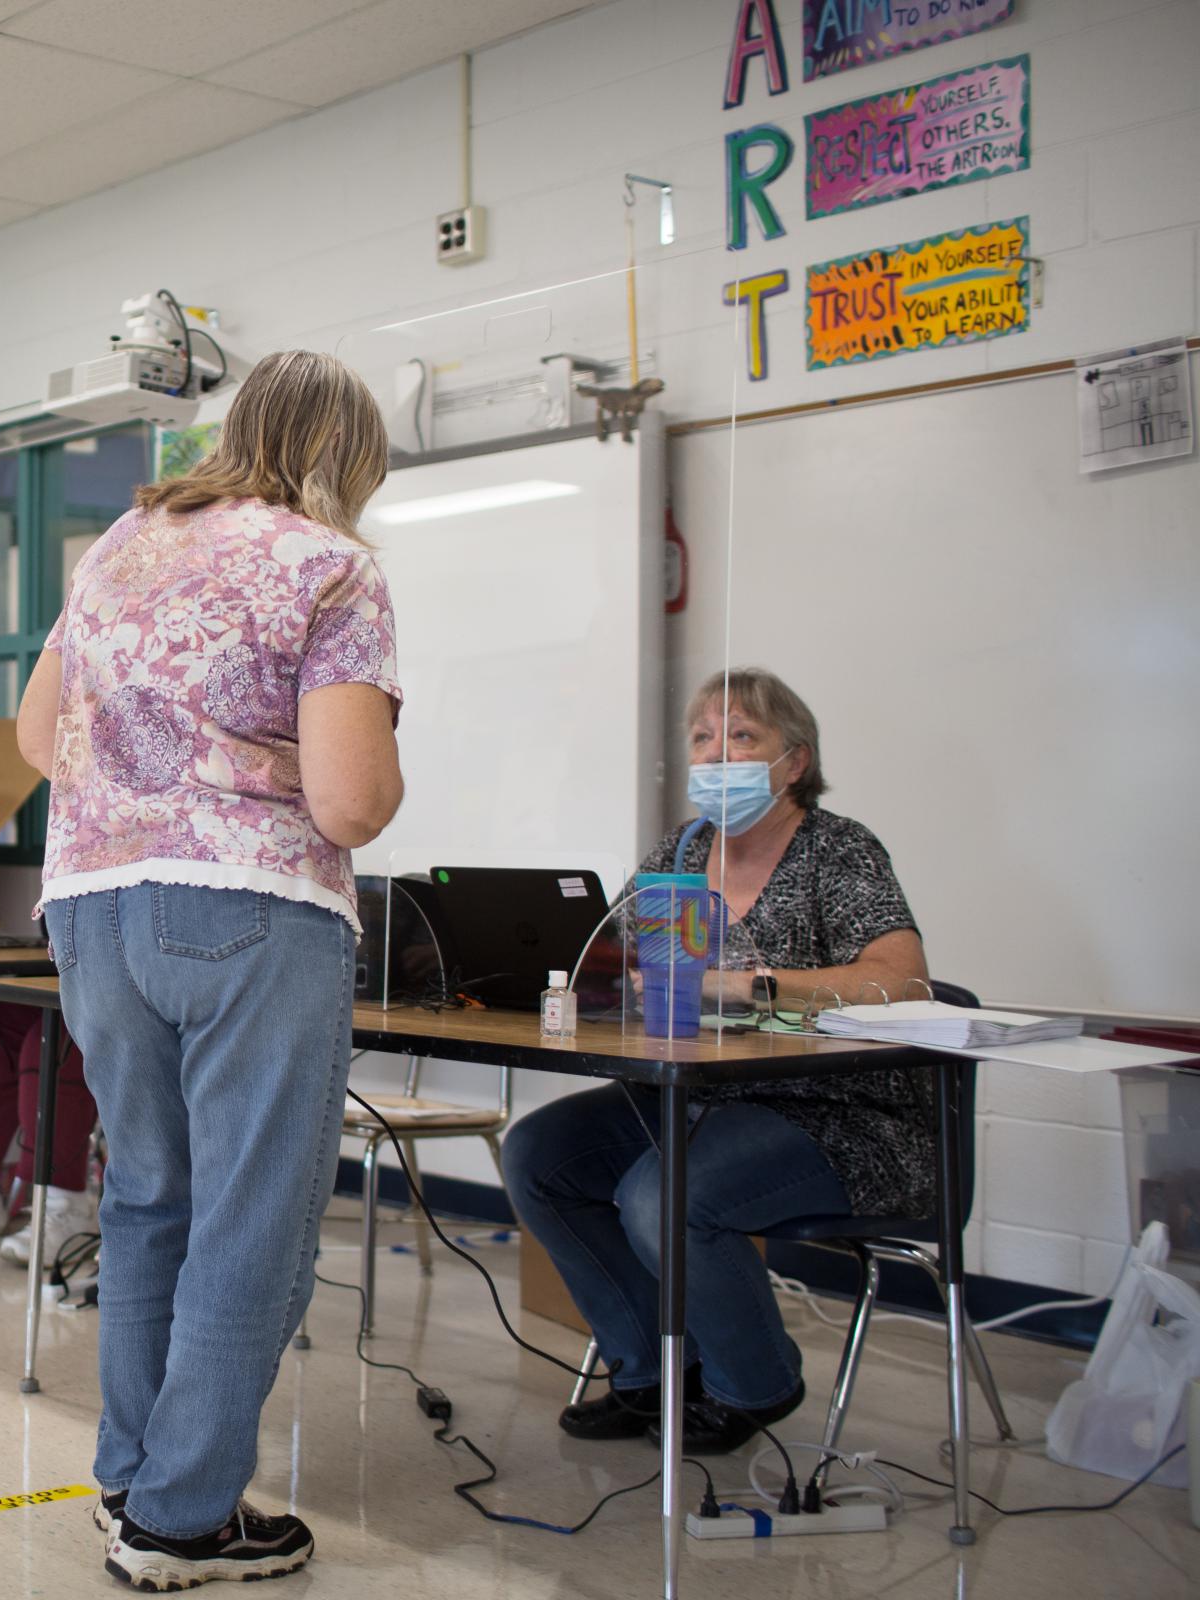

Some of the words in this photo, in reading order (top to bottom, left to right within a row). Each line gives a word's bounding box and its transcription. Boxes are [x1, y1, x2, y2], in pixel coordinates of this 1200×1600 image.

[894, 8, 920, 26] TO
[928, 0, 952, 19] DO
[921, 106, 1012, 149] OTHERS.
[813, 113, 918, 190] RESPECT
[916, 156, 946, 180] THE
[910, 258, 929, 279] IN
[935, 239, 1021, 272] YOURSELF
[811, 272, 903, 331] TRUST
[902, 295, 953, 323] YOUR
[954, 280, 1028, 318] ABILITY
[913, 327, 932, 343] TO
[944, 307, 1023, 336] LEARN.
